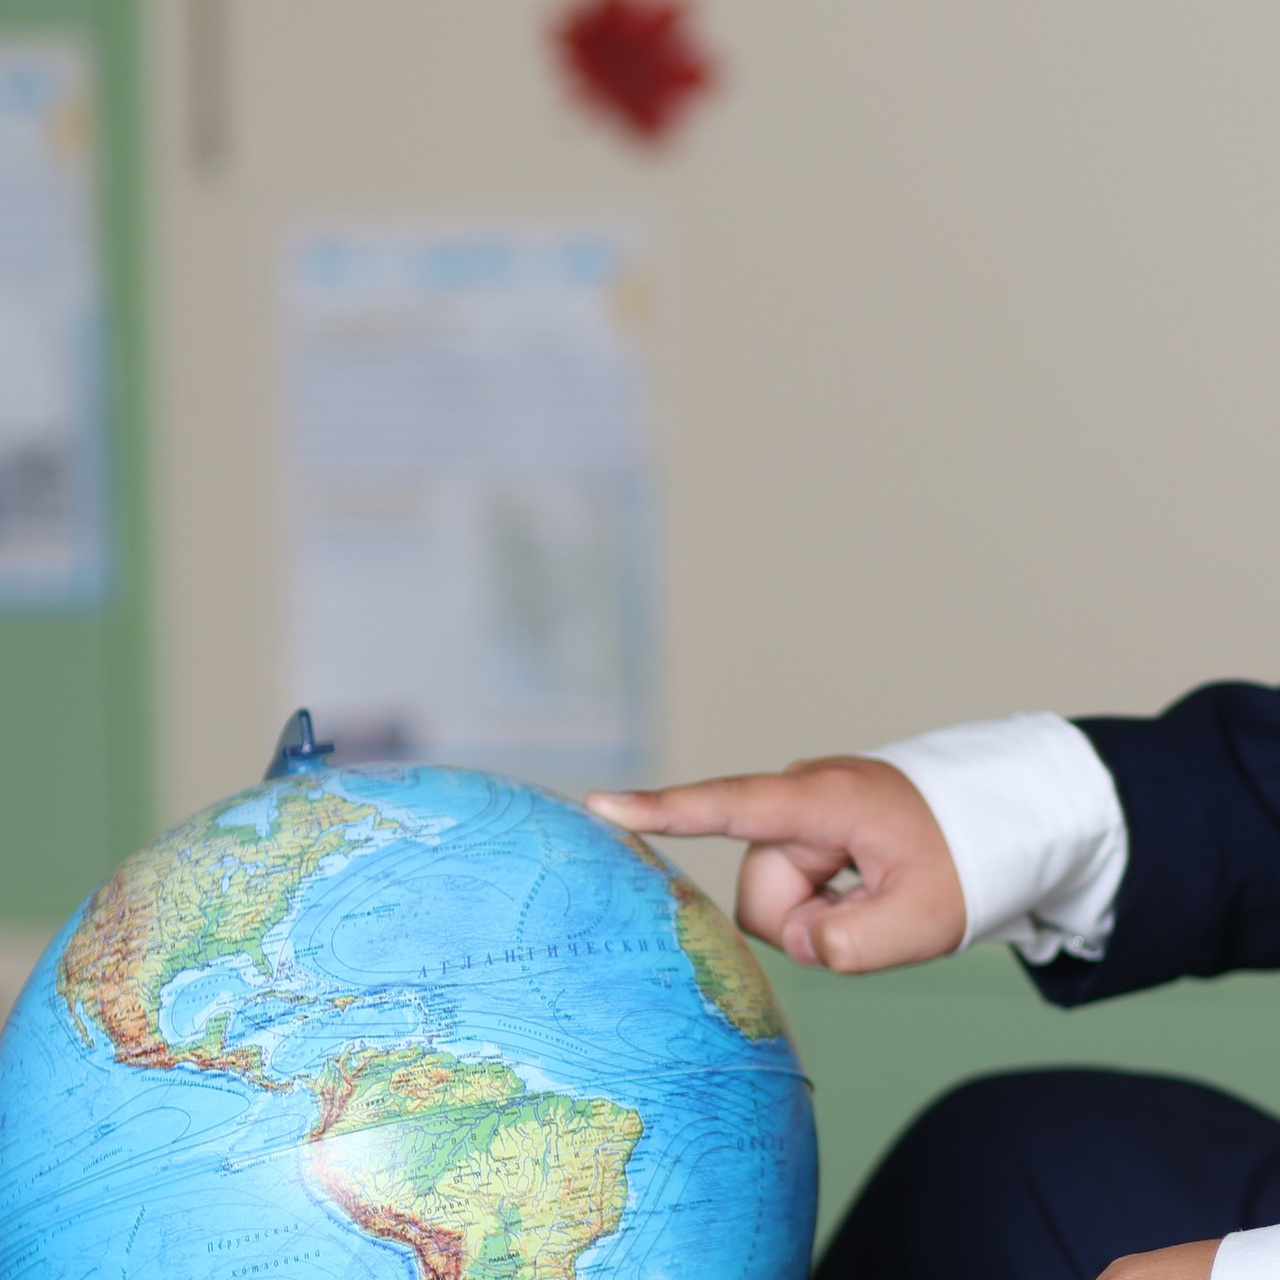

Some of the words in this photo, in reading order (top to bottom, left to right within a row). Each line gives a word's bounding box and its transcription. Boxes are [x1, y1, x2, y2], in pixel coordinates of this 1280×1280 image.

[417, 937, 668, 979] АТЛАНТИЧЕСКИЙ
[420, 1199, 470, 1216] БОЛИВИЯ
[206, 1222, 300, 1253] Перуанская
[231, 1248, 321, 1278] котловина
[488, 1251, 521, 1264] ПАРАГВАЙ
